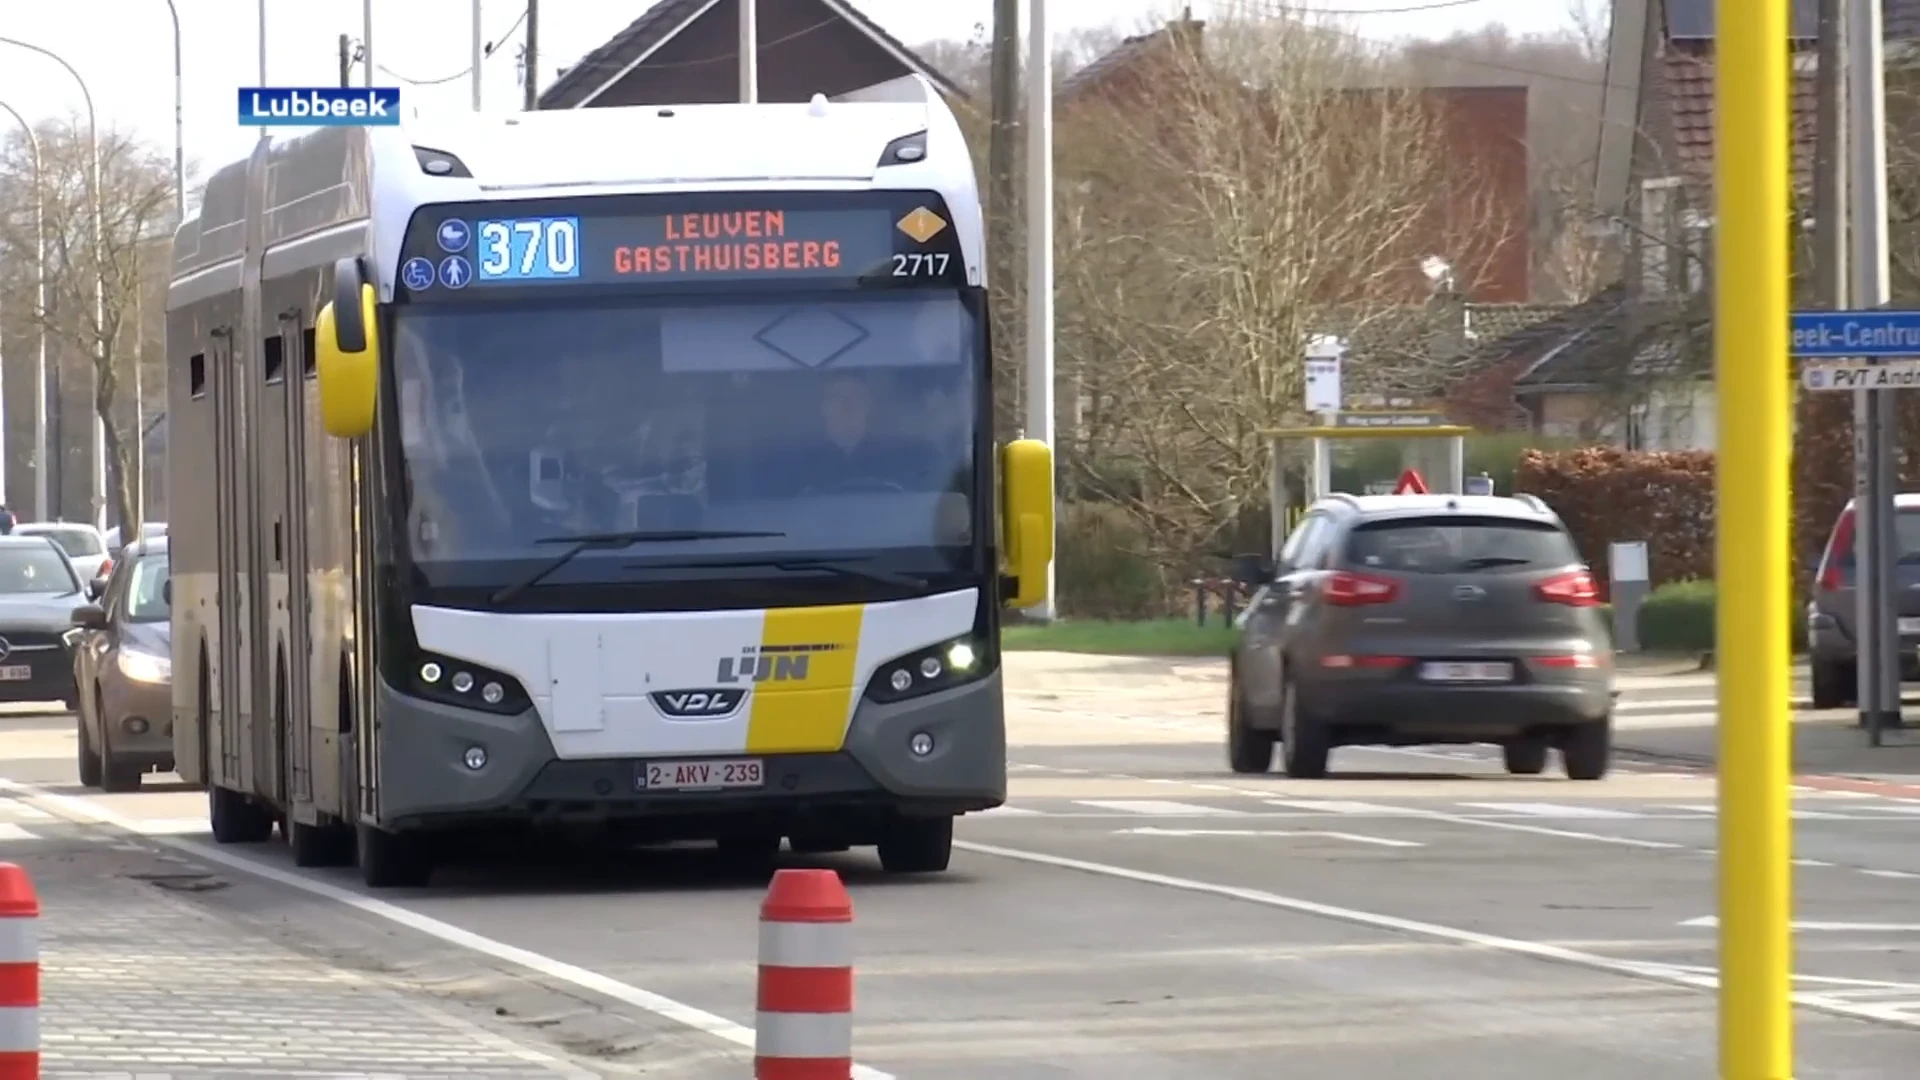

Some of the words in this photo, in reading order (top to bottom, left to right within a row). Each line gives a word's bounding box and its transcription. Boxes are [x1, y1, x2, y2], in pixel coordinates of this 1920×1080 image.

[665, 210, 784, 240] LEUVEN
[481, 220, 577, 276] 370
[614, 241, 840, 273] GASTHUISBERG
[892, 253, 950, 277] 2717
[1789, 321, 1920, 348] eek-Centru
[1833, 369, 1869, 386] PVT
[716, 655, 809, 683] LIJN
[664, 692, 730, 711] VDL
[649, 763, 761, 786] 2-AKV-239
